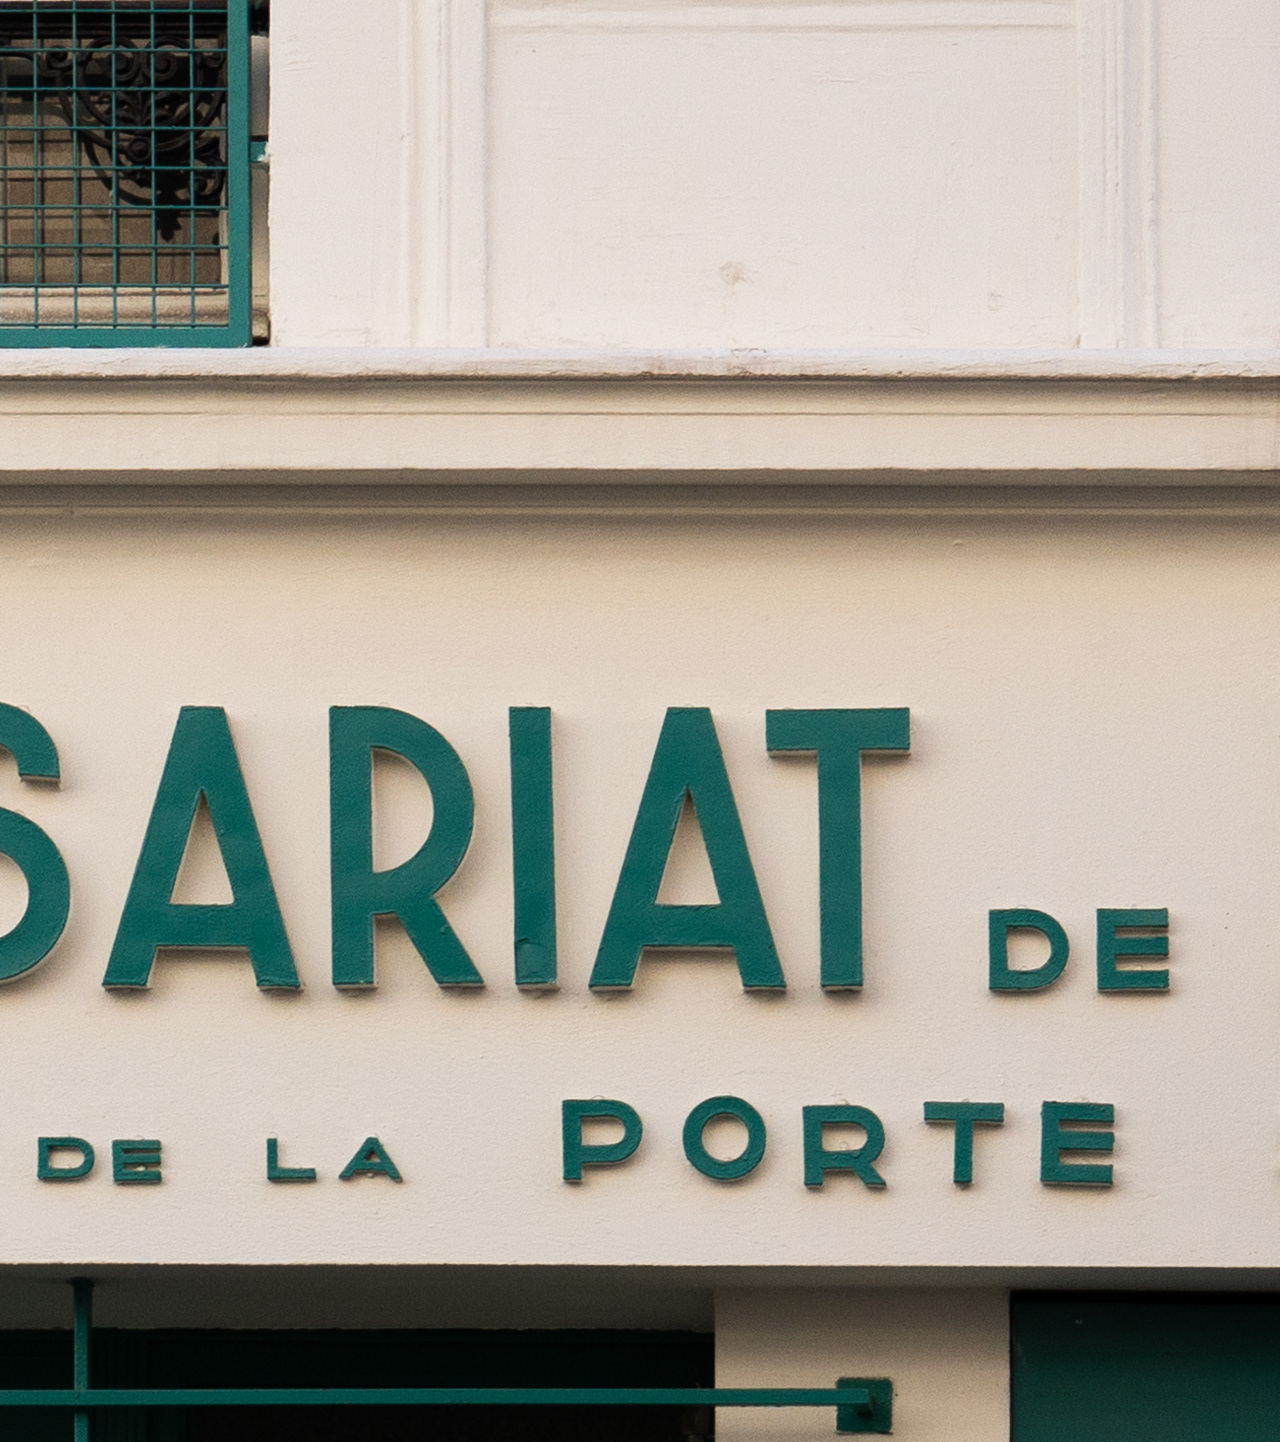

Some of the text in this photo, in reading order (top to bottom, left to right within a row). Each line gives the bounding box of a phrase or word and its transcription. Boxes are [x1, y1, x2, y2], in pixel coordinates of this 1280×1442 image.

[988, 909, 1169, 990] DE
[37, 1138, 161, 1183] DE
[267, 1138, 400, 1181] LA
[562, 1099, 1114, 1189] PORTE
